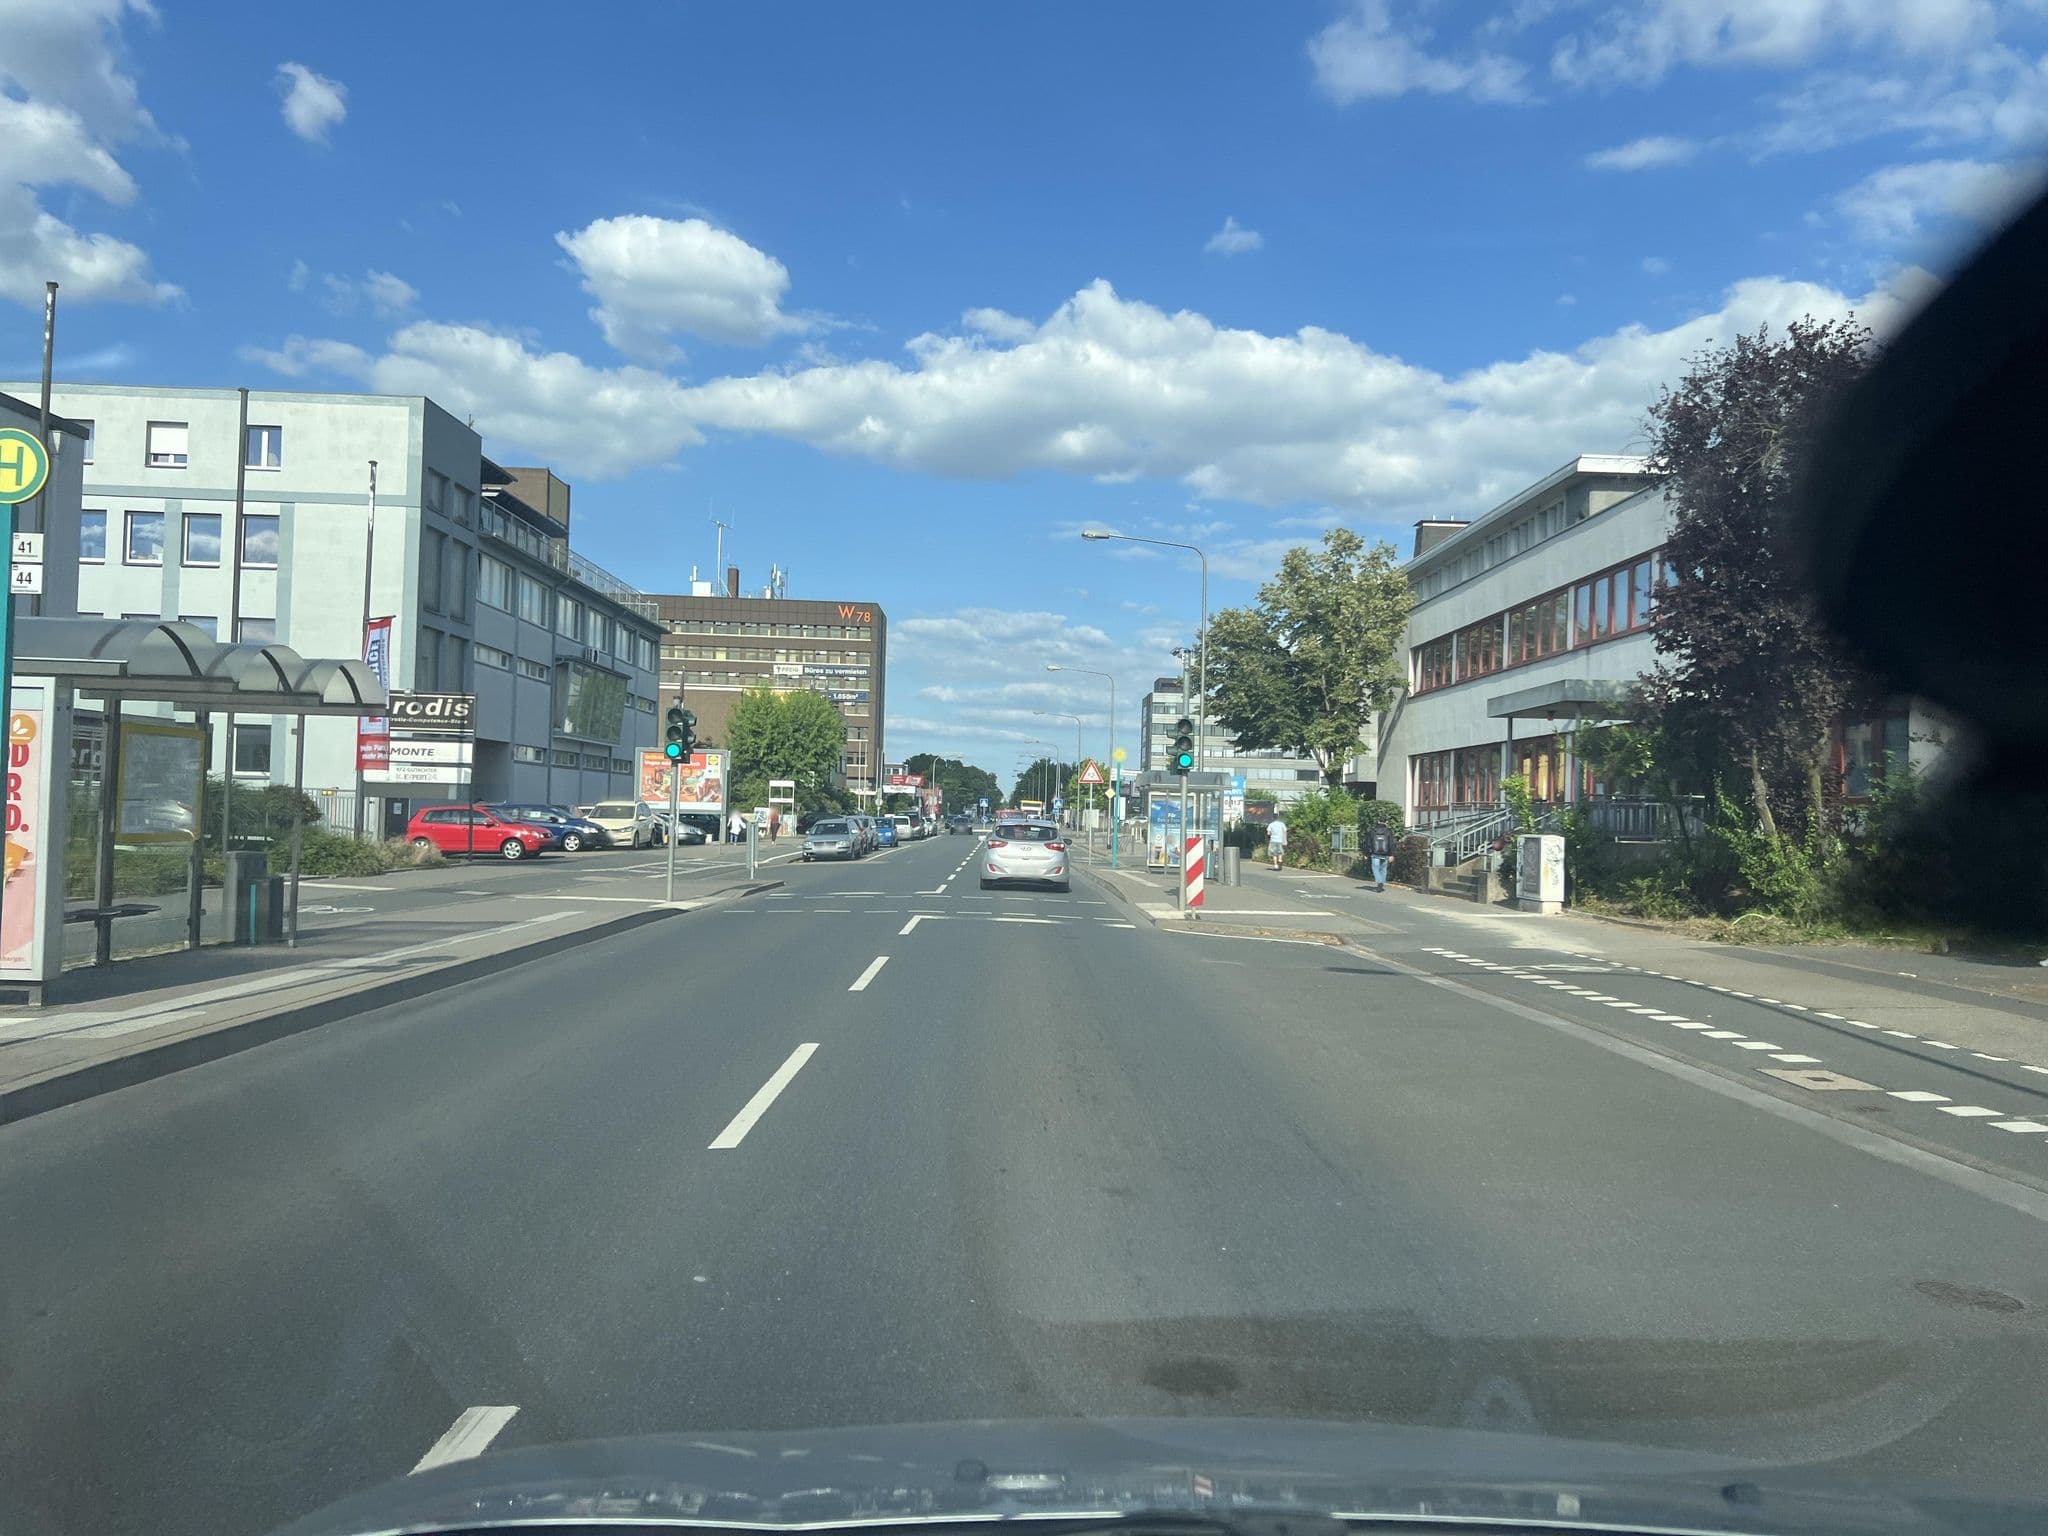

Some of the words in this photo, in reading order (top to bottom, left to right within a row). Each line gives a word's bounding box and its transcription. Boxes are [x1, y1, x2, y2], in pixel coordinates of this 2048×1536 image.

[0, 446, 24, 486] H
[18, 541, 32, 553] 41
[16, 572, 32, 584] 44
[838, 605, 855, 619] W
[856, 611, 871, 623] 78
[392, 698, 469, 717] rodis
[390, 747, 435, 756] MONTE
